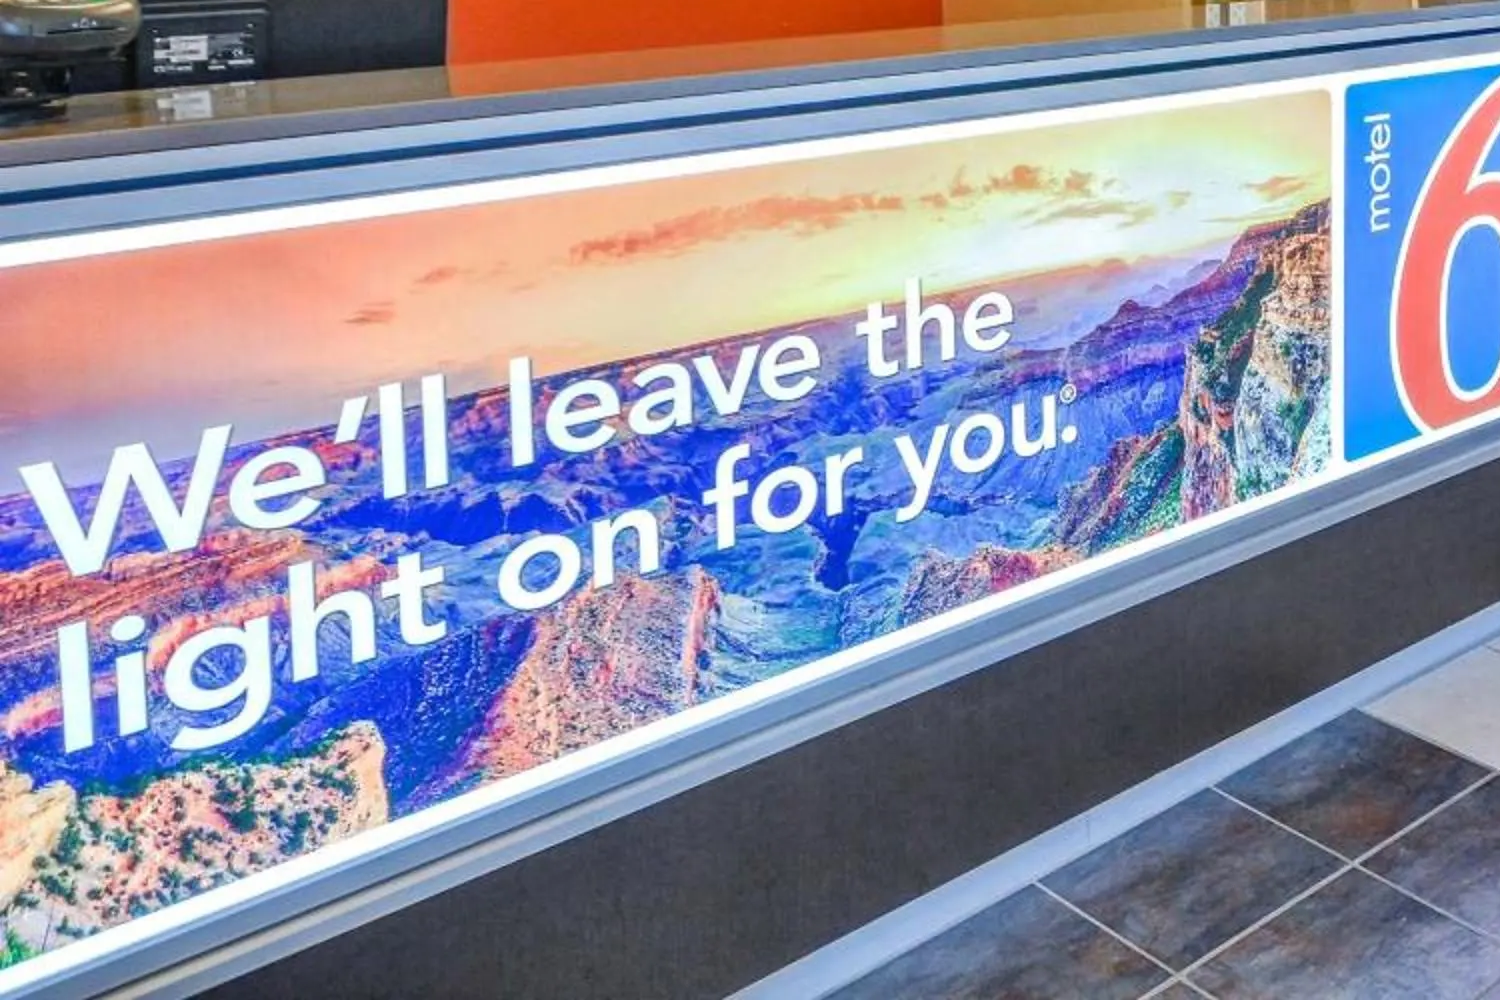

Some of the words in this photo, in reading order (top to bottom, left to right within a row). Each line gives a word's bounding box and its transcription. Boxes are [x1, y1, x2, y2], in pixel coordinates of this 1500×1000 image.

[1363, 112, 1392, 233] motel
[18, 372, 450, 577] We'll
[508, 334, 822, 468] leave
[856, 277, 1016, 379] the
[57, 551, 448, 754] light
[497, 506, 660, 611] on
[702, 443, 864, 551] for
